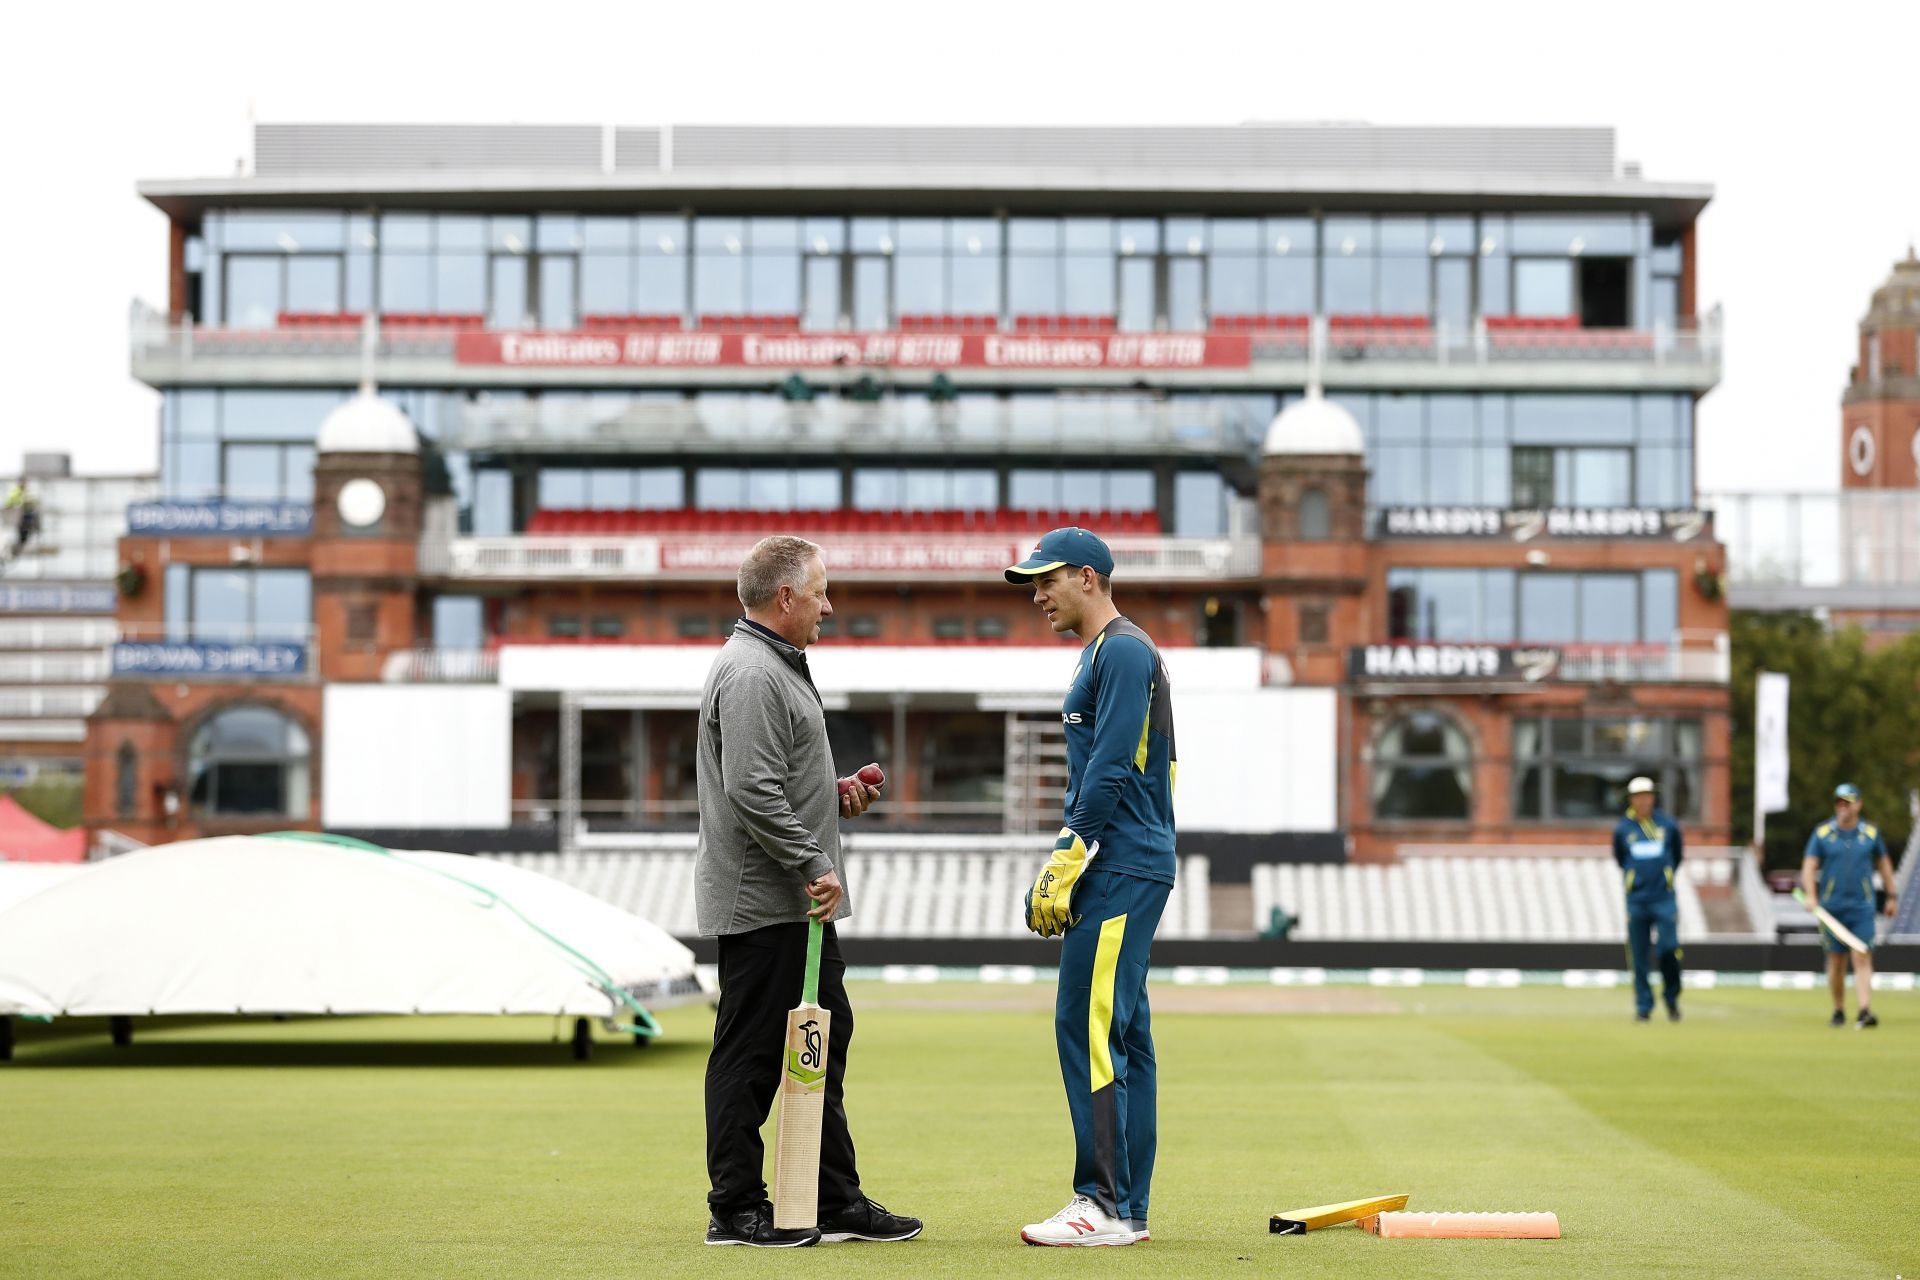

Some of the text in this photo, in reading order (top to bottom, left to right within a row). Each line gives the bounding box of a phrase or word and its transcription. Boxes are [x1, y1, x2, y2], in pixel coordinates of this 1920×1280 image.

[502, 336, 620, 363] Emirates
[743, 335, 861, 364] Emirates
[984, 336, 1103, 365] Emirates
[130, 504, 313, 530] BROWN SHIPLEY
[1387, 509, 1660, 534] HARDYS HARDYS
[114, 645, 300, 671] BROWN SHIPLEY
[1364, 645, 1500, 675] HARDYS
